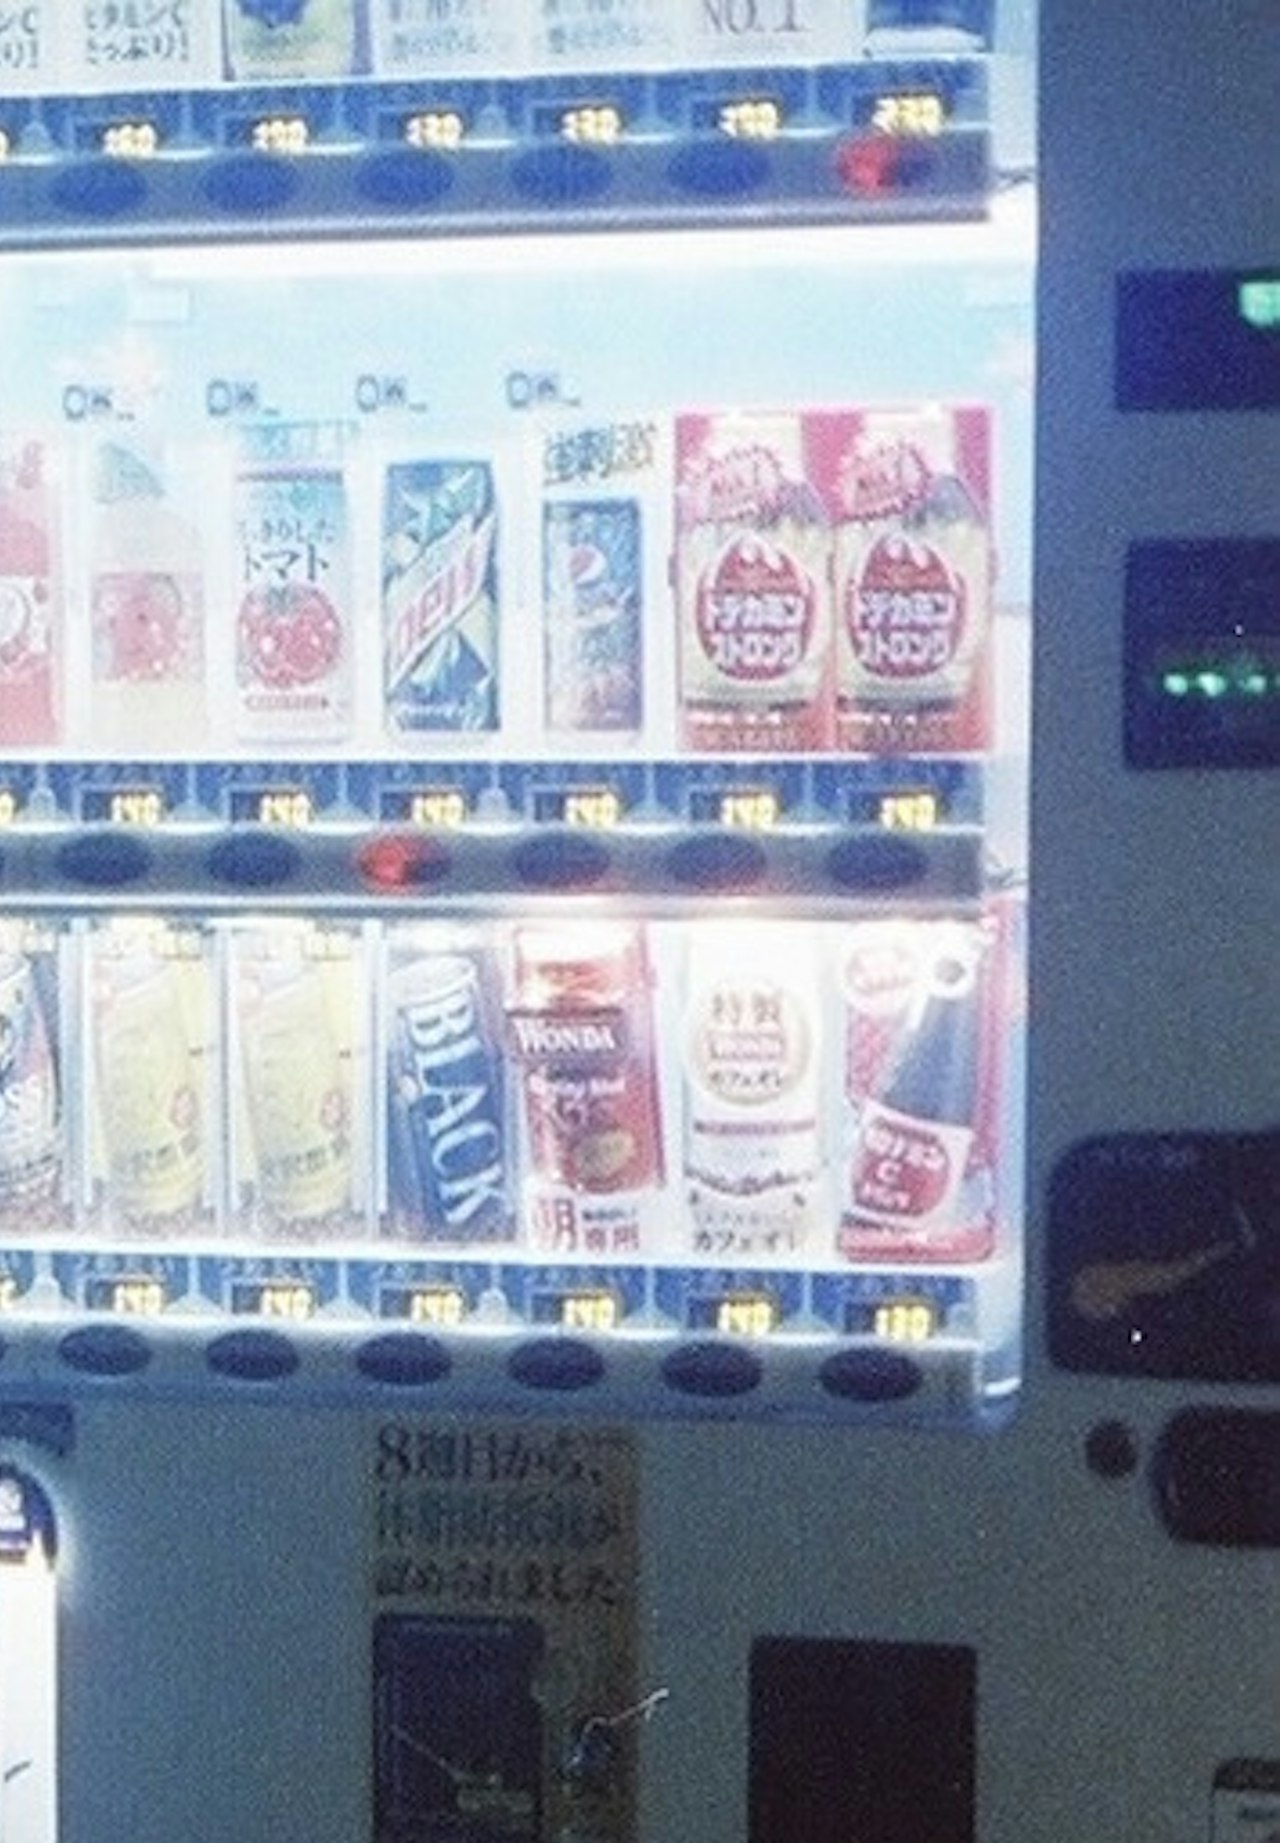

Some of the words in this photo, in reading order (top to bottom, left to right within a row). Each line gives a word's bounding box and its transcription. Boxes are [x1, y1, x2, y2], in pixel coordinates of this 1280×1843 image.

[243, 543, 331, 583] トマト
[515, 1020, 617, 1053] WONDA
[397, 988, 506, 1226] BLACK
